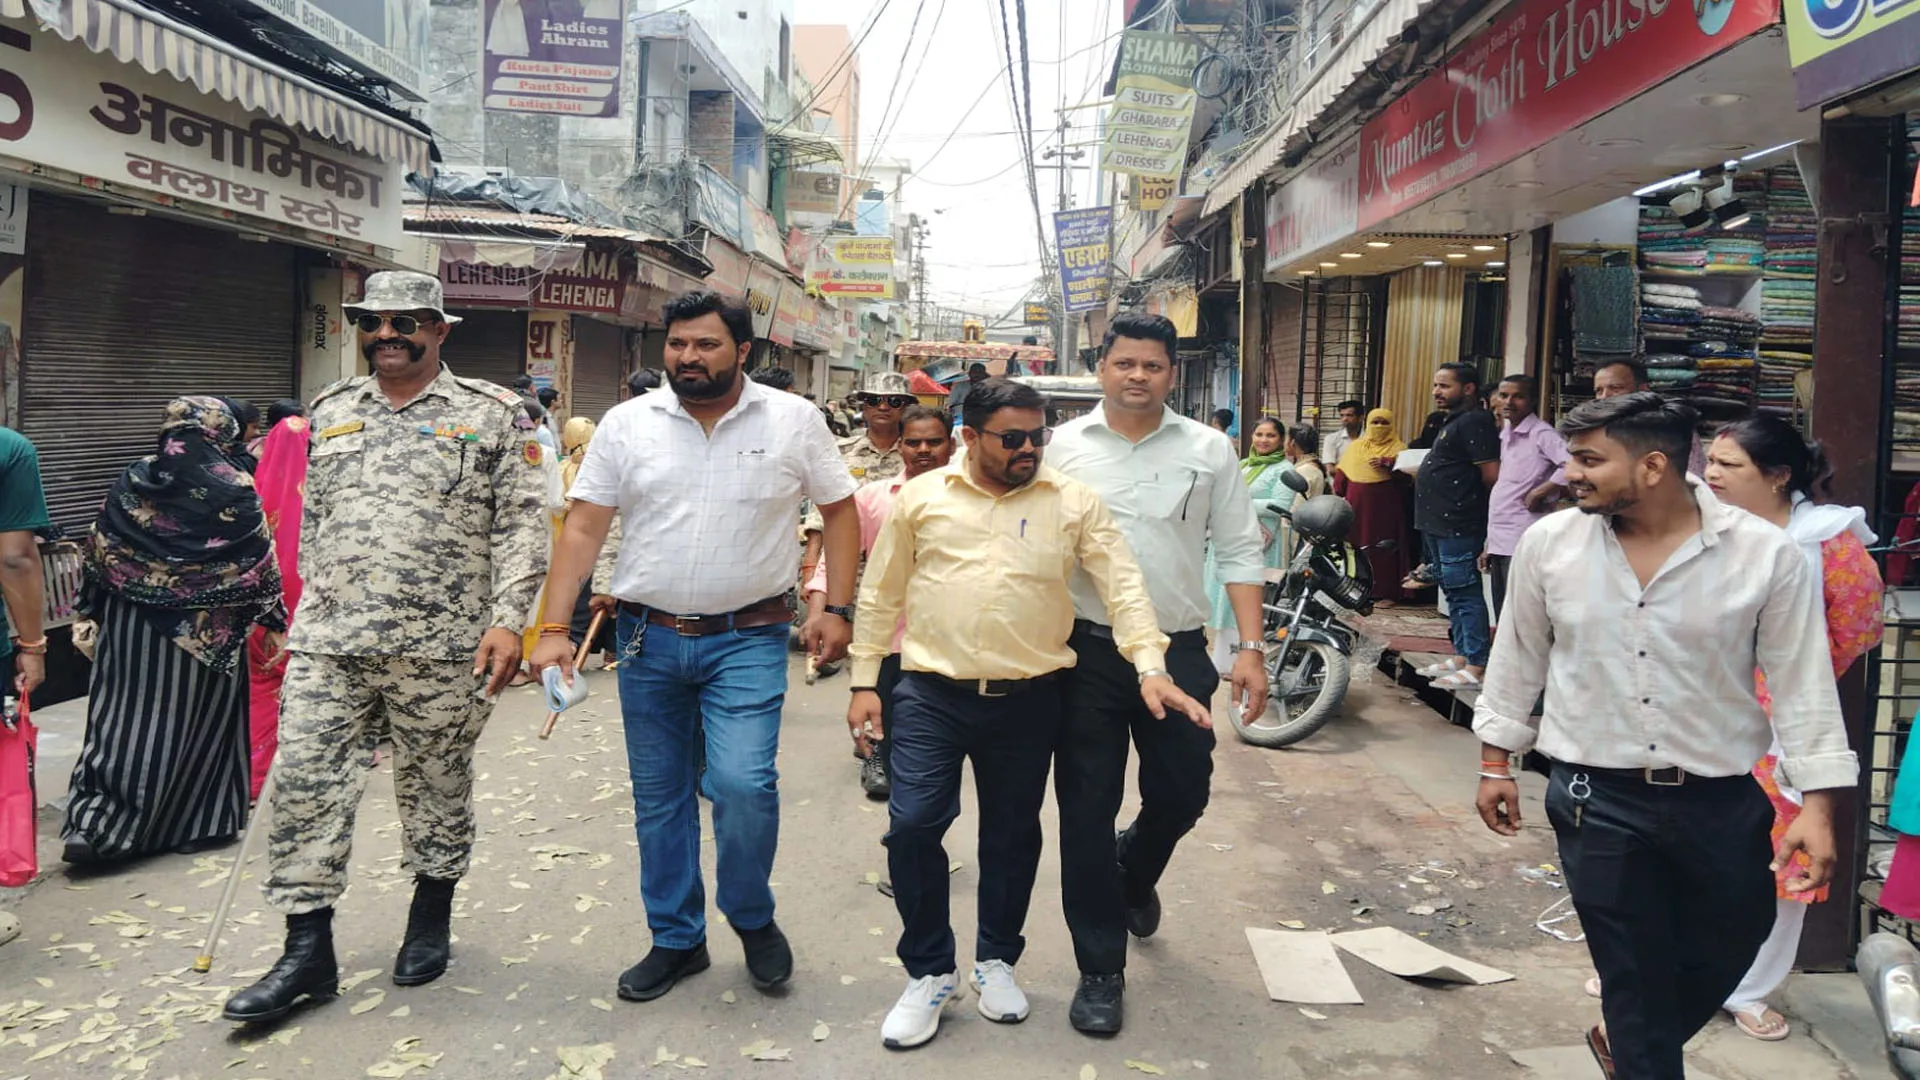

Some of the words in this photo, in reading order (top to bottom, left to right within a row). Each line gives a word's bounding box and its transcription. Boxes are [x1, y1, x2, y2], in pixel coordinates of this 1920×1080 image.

[541, 19, 609, 34] Ladies
[541, 33, 610, 48] Ahram
[1123, 37, 1198, 65] SHAMA
[506, 61, 551, 73] Kurta
[553, 64, 612, 77] Pajama
[518, 80, 551, 91] Pant
[554, 83, 588, 94] Shirt
[1452, 38, 1526, 150] Cloth
[508, 97, 551, 109] Ladies
[555, 100, 582, 111] Suit
[1132, 91, 1175, 107] SUITS
[1120, 111, 1177, 127] GHARARA
[89, 82, 383, 208] अनामिका
[1116, 133, 1174, 150] LEHENGA
[1115, 154, 1167, 170] DRESSES
[125, 152, 268, 211] क्लाथ
[281, 195, 365, 236] स्टोर
[447, 262, 529, 286] LEHENGA
[540, 282, 616, 308] LEHENGA
